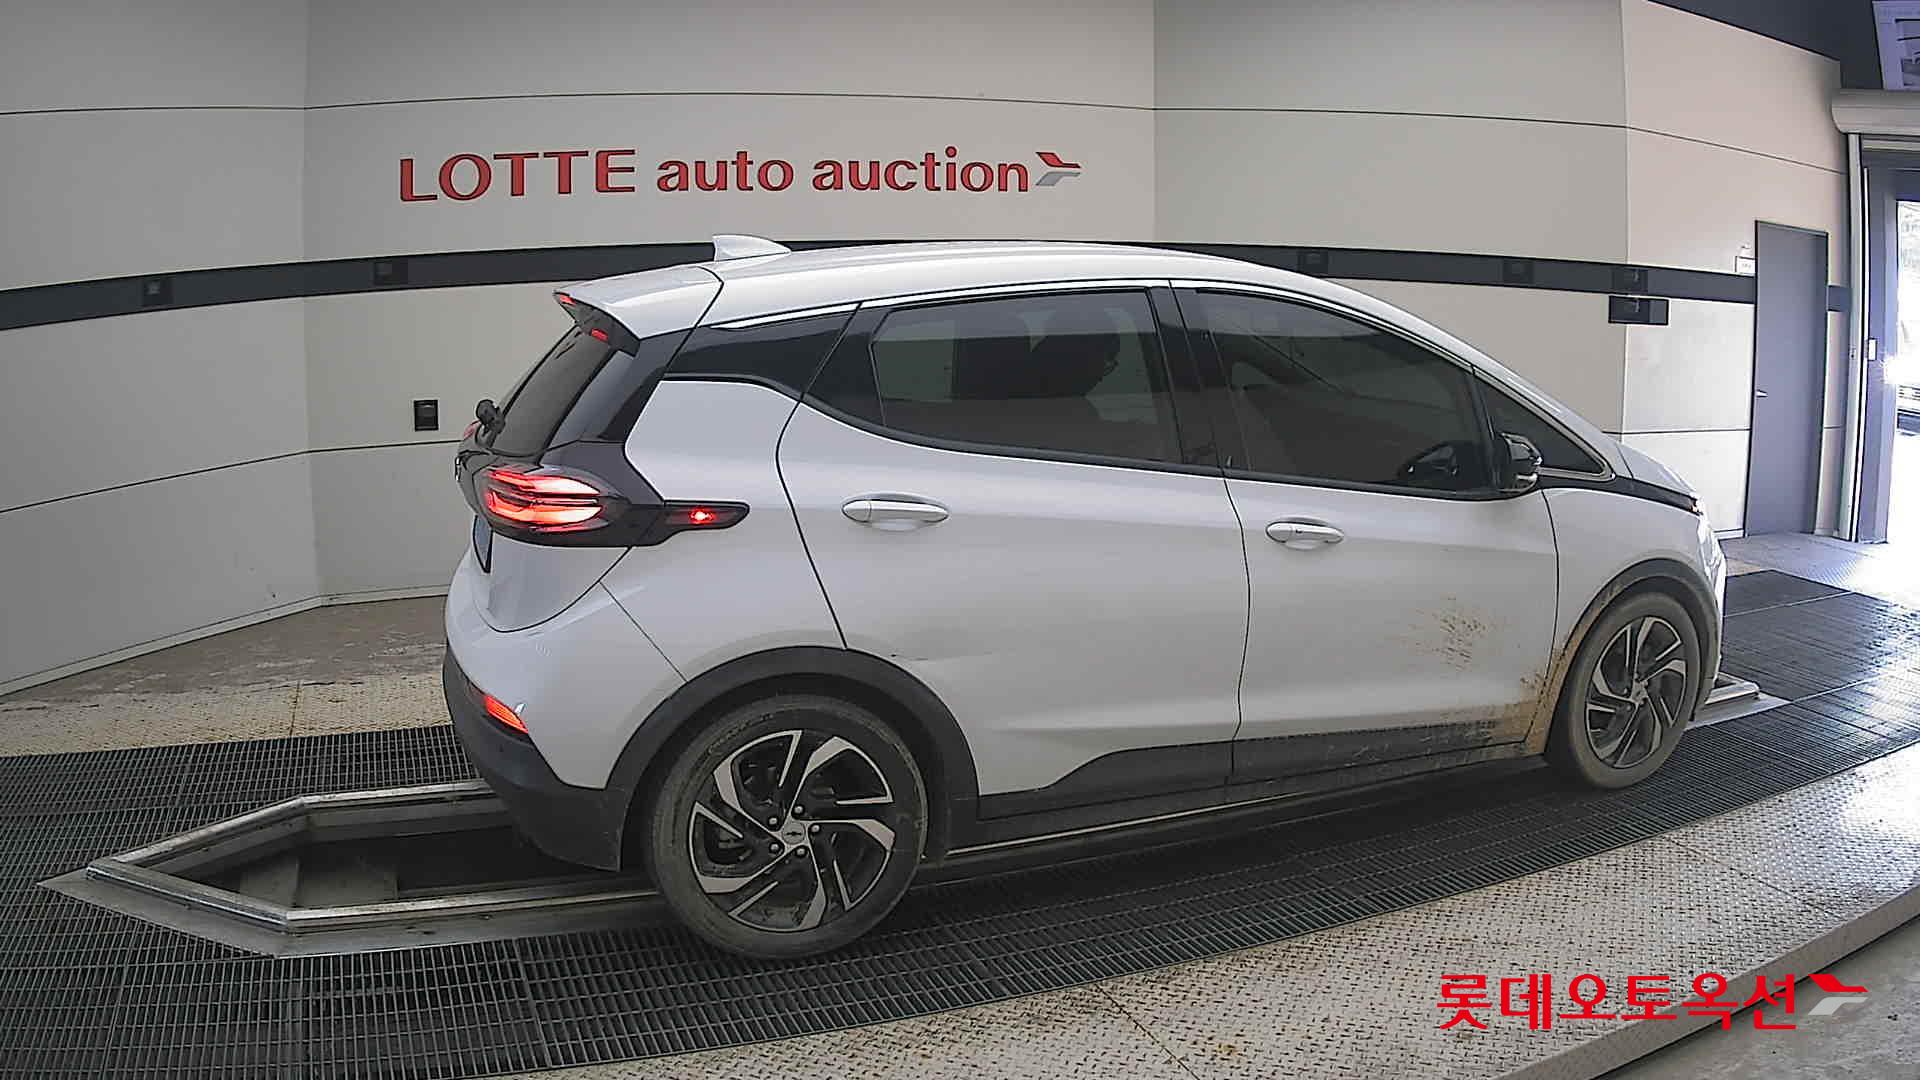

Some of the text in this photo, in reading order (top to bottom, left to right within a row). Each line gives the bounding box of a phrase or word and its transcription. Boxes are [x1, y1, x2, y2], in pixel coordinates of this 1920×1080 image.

[400, 146, 1029, 201] LOTTE auto auction
